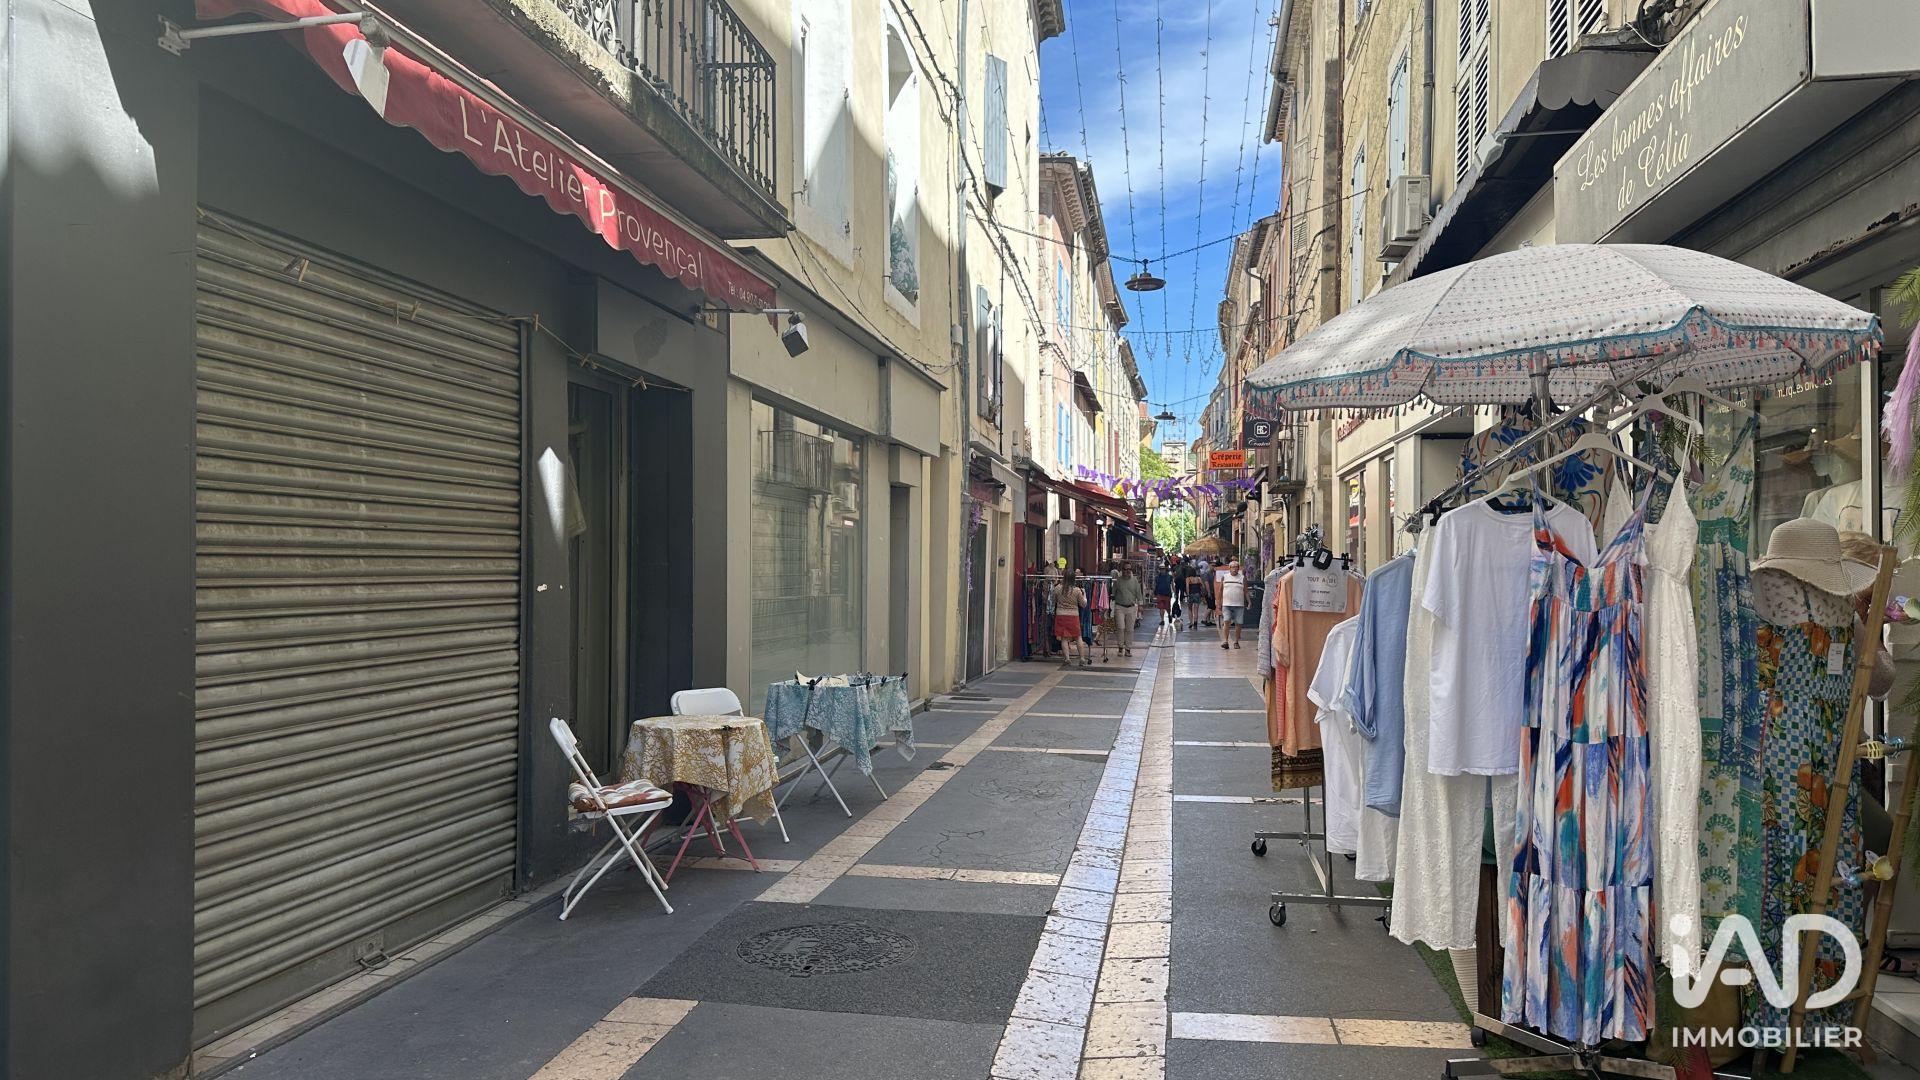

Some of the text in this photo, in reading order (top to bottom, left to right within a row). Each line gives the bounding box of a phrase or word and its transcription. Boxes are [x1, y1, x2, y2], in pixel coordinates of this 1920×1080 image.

[459, 96, 704, 280] L'Atelier Provençal
[1577, 15, 1749, 191] Les bonnes affaires
[1617, 121, 1693, 212] de Célia
